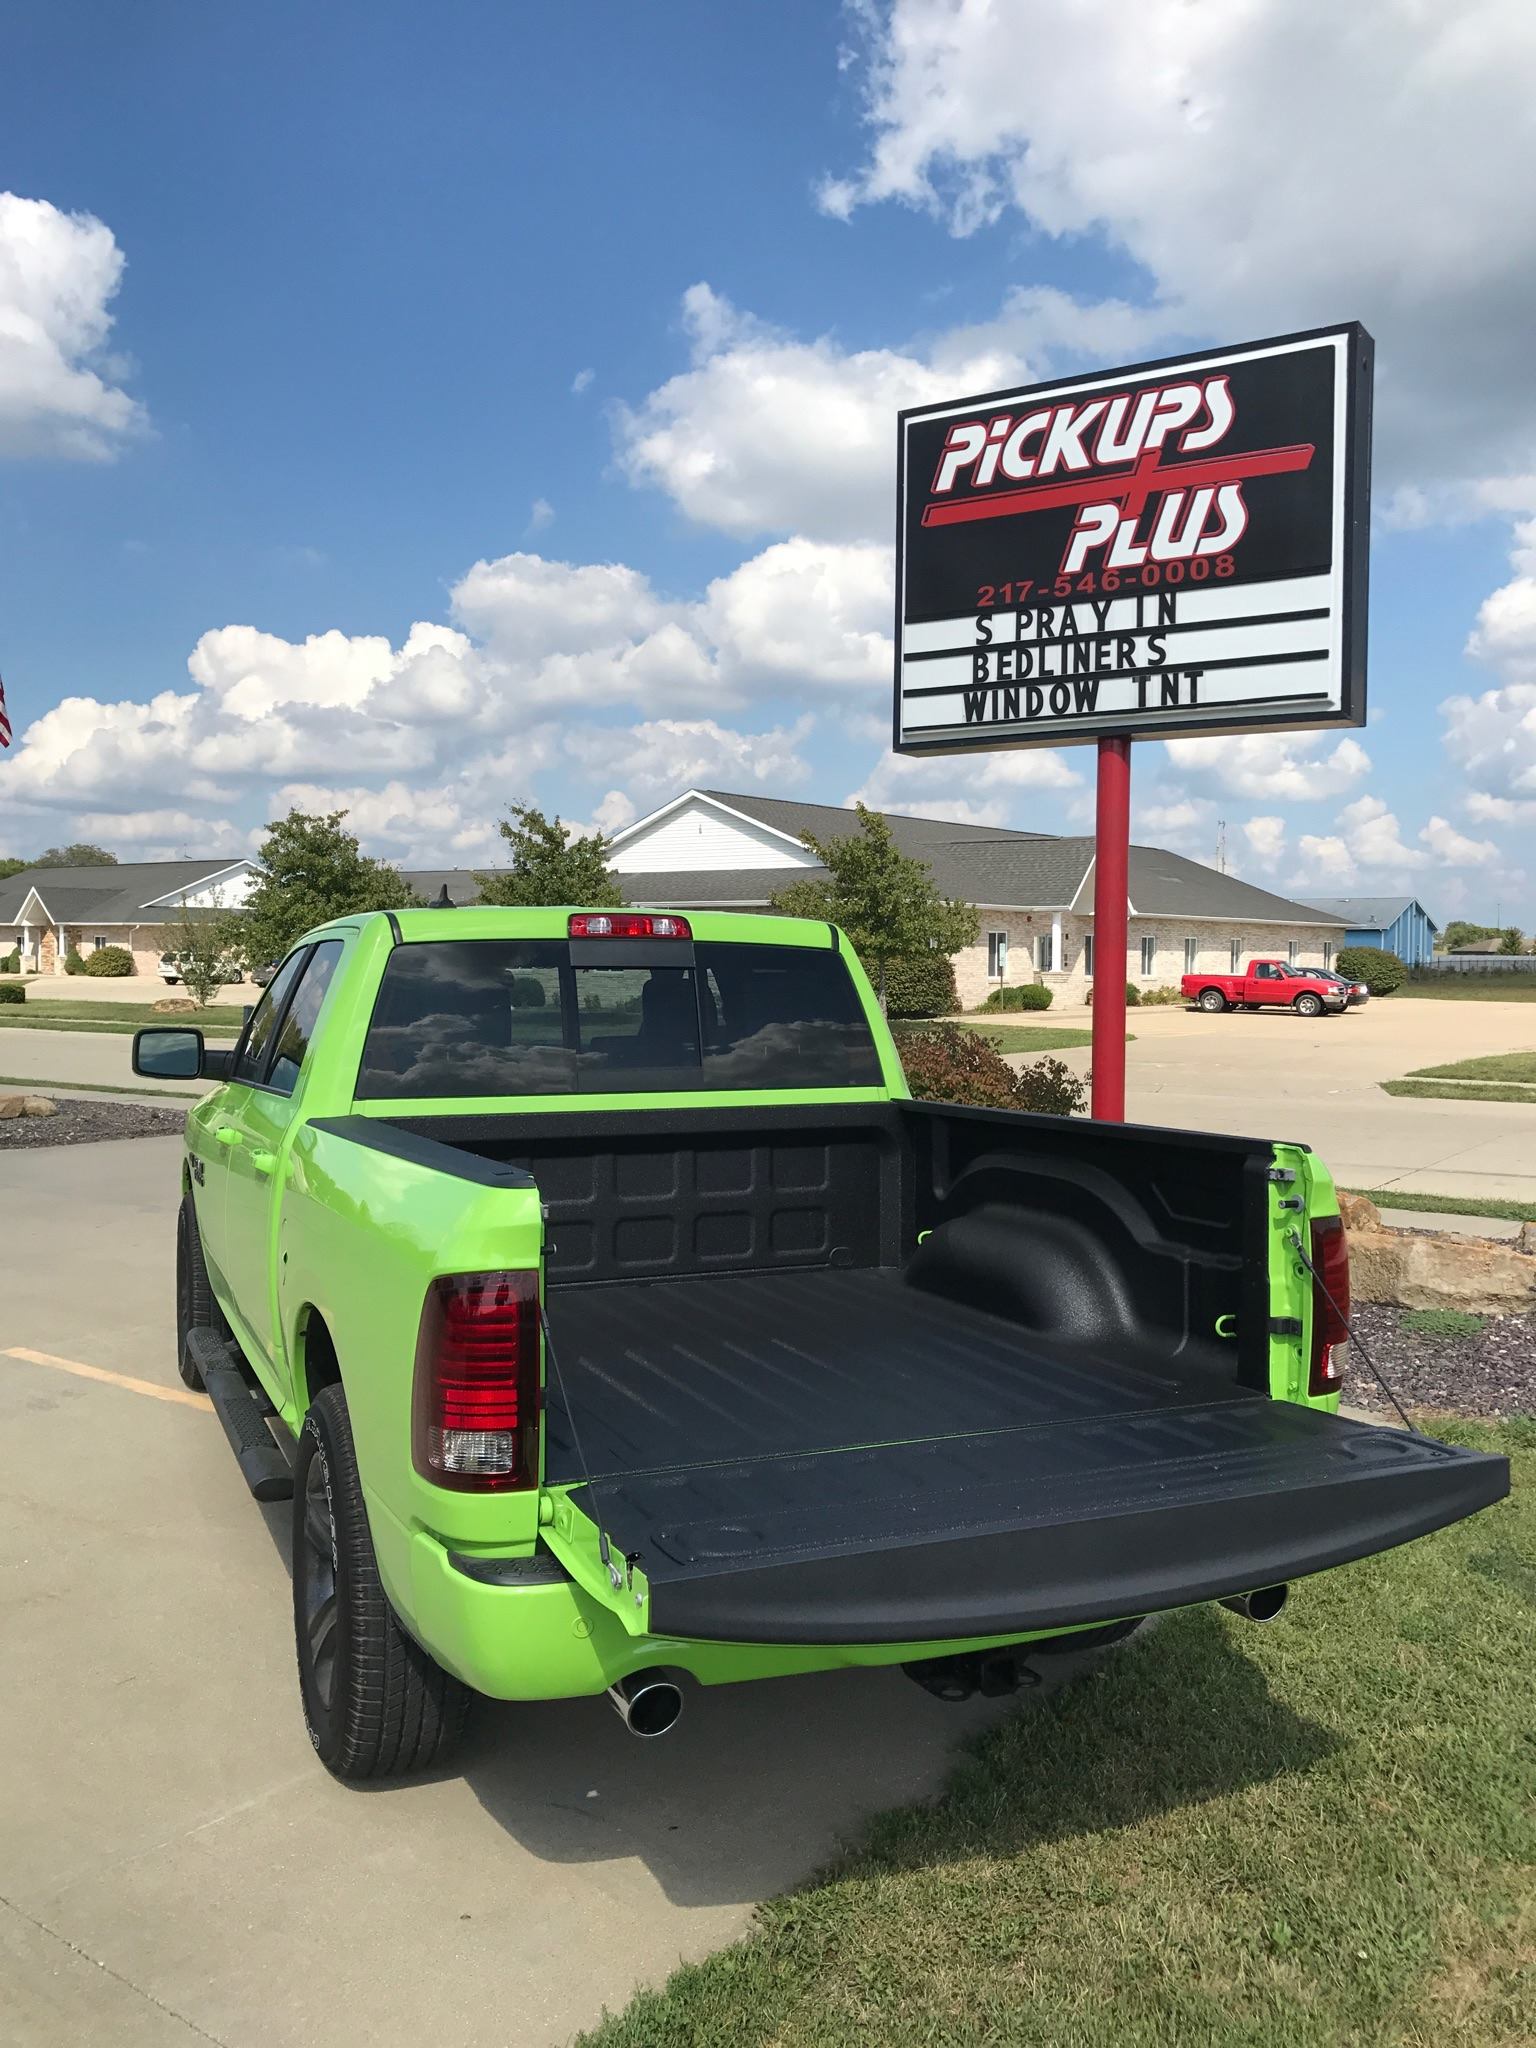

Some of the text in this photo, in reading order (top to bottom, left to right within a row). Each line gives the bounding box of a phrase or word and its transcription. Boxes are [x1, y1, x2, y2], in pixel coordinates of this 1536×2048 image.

[1059, 480, 1249, 574] PLUS
[976, 554, 1236, 608] 217-546-0008
[1136, 590, 1177, 629] IN
[972, 632, 1168, 684] BEDLINERS
[963, 679, 1100, 723] WINDOW
